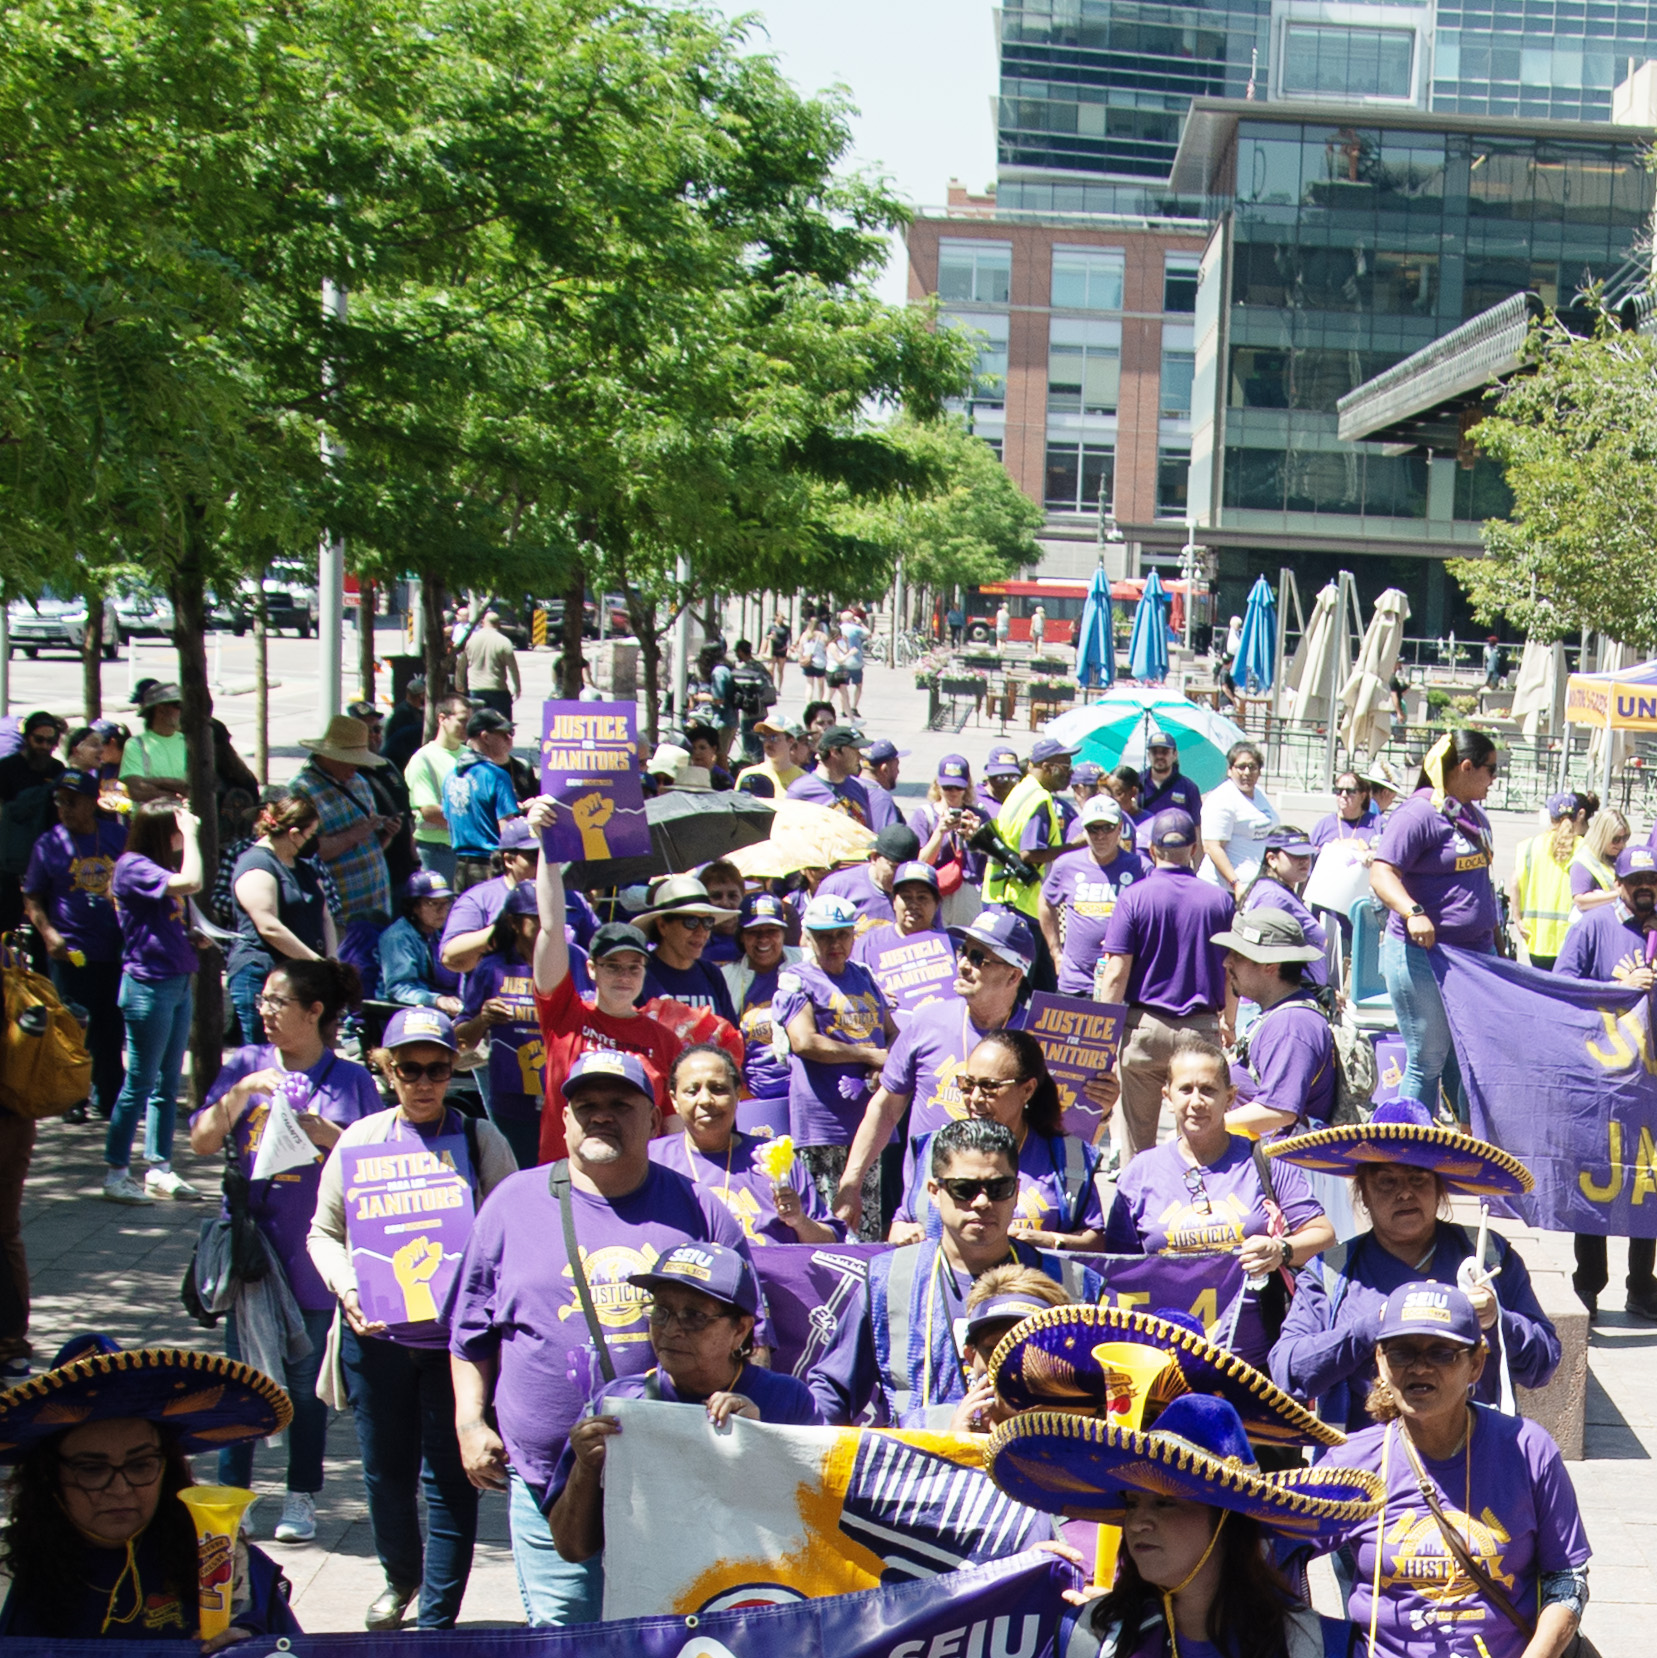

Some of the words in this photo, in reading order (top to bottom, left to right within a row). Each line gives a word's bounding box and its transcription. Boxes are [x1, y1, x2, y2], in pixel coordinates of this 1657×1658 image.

[550, 715, 628, 740] JUSTICE
[548, 750, 631, 771] JANITORS
[825, 904, 844, 921] LA
[1035, 1007, 1117, 1040] JUSTICE
[1066, 1036, 1080, 1046] FOR
[1041, 1044, 1109, 1070] ANITORS
[280, 1111, 302, 1145] CHANTS
[353, 1150, 459, 1183] JUSTICIA
[356, 1185, 464, 1220] JANITORS
[1171, 1226, 1238, 1247] JUSTICIA
[669, 1248, 714, 1269] SEIU
[592, 1283, 654, 1304] USTICIA
[1403, 1291, 1449, 1309] SEIU
